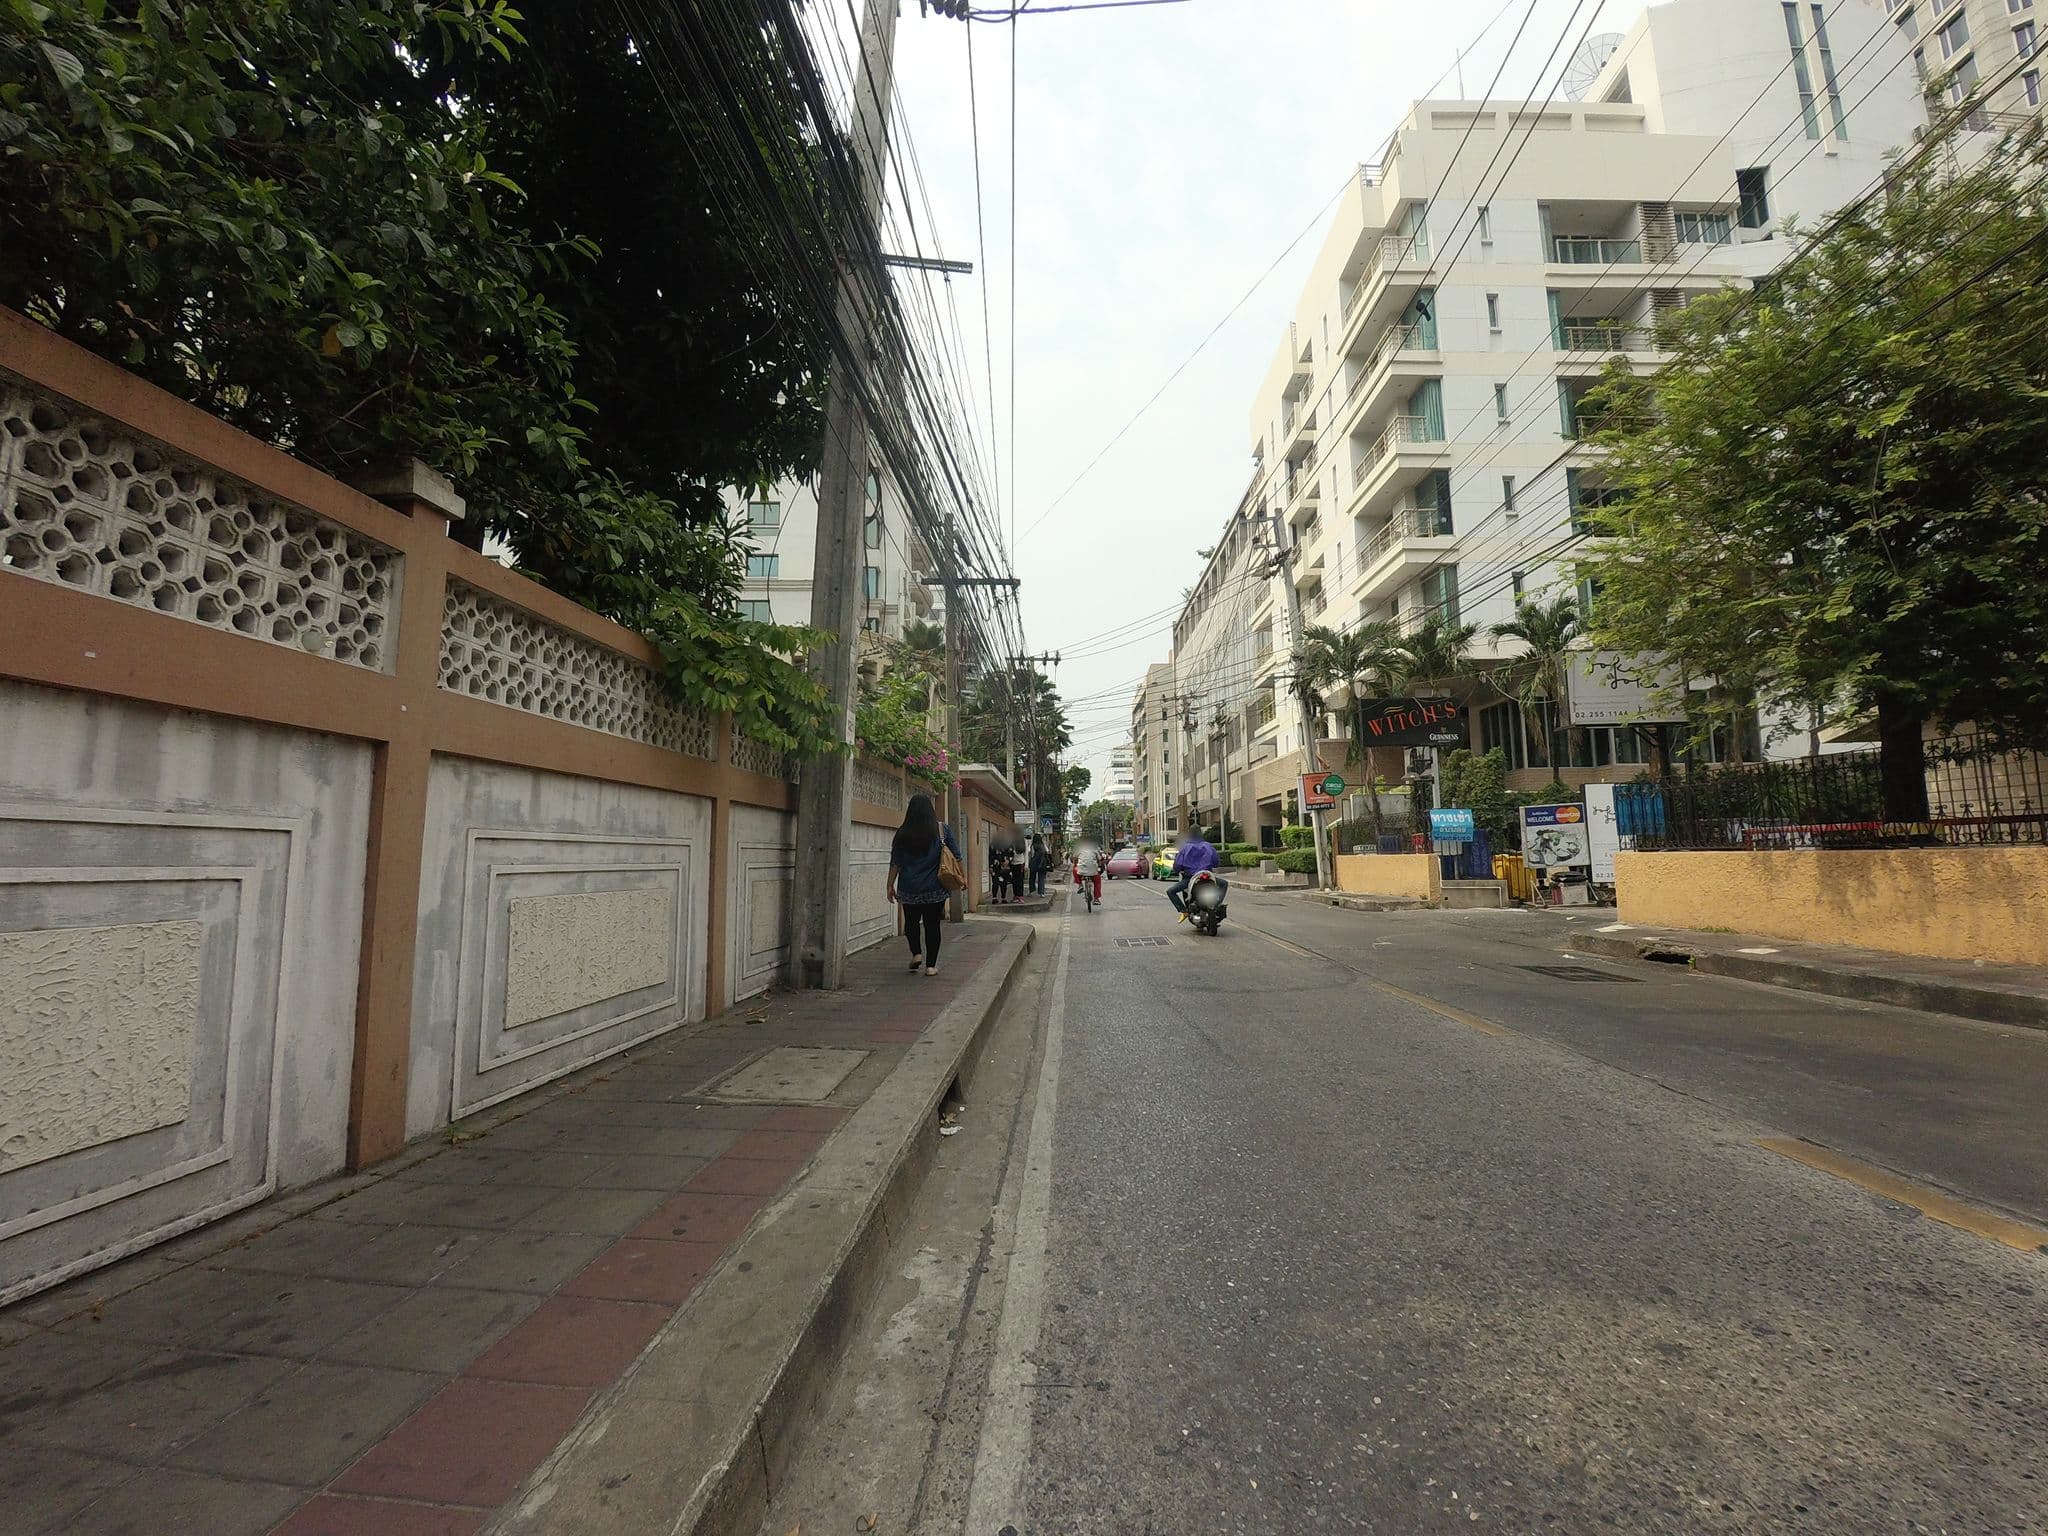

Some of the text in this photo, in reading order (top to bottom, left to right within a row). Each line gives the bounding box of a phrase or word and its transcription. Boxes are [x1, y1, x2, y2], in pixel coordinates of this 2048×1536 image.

[1367, 700, 1457, 737] WITCH'S
[1429, 733, 1459, 741] GUINNESS
[1431, 810, 1471, 823] ทางเข้า
[1527, 815, 1555, 823] WELCOME
